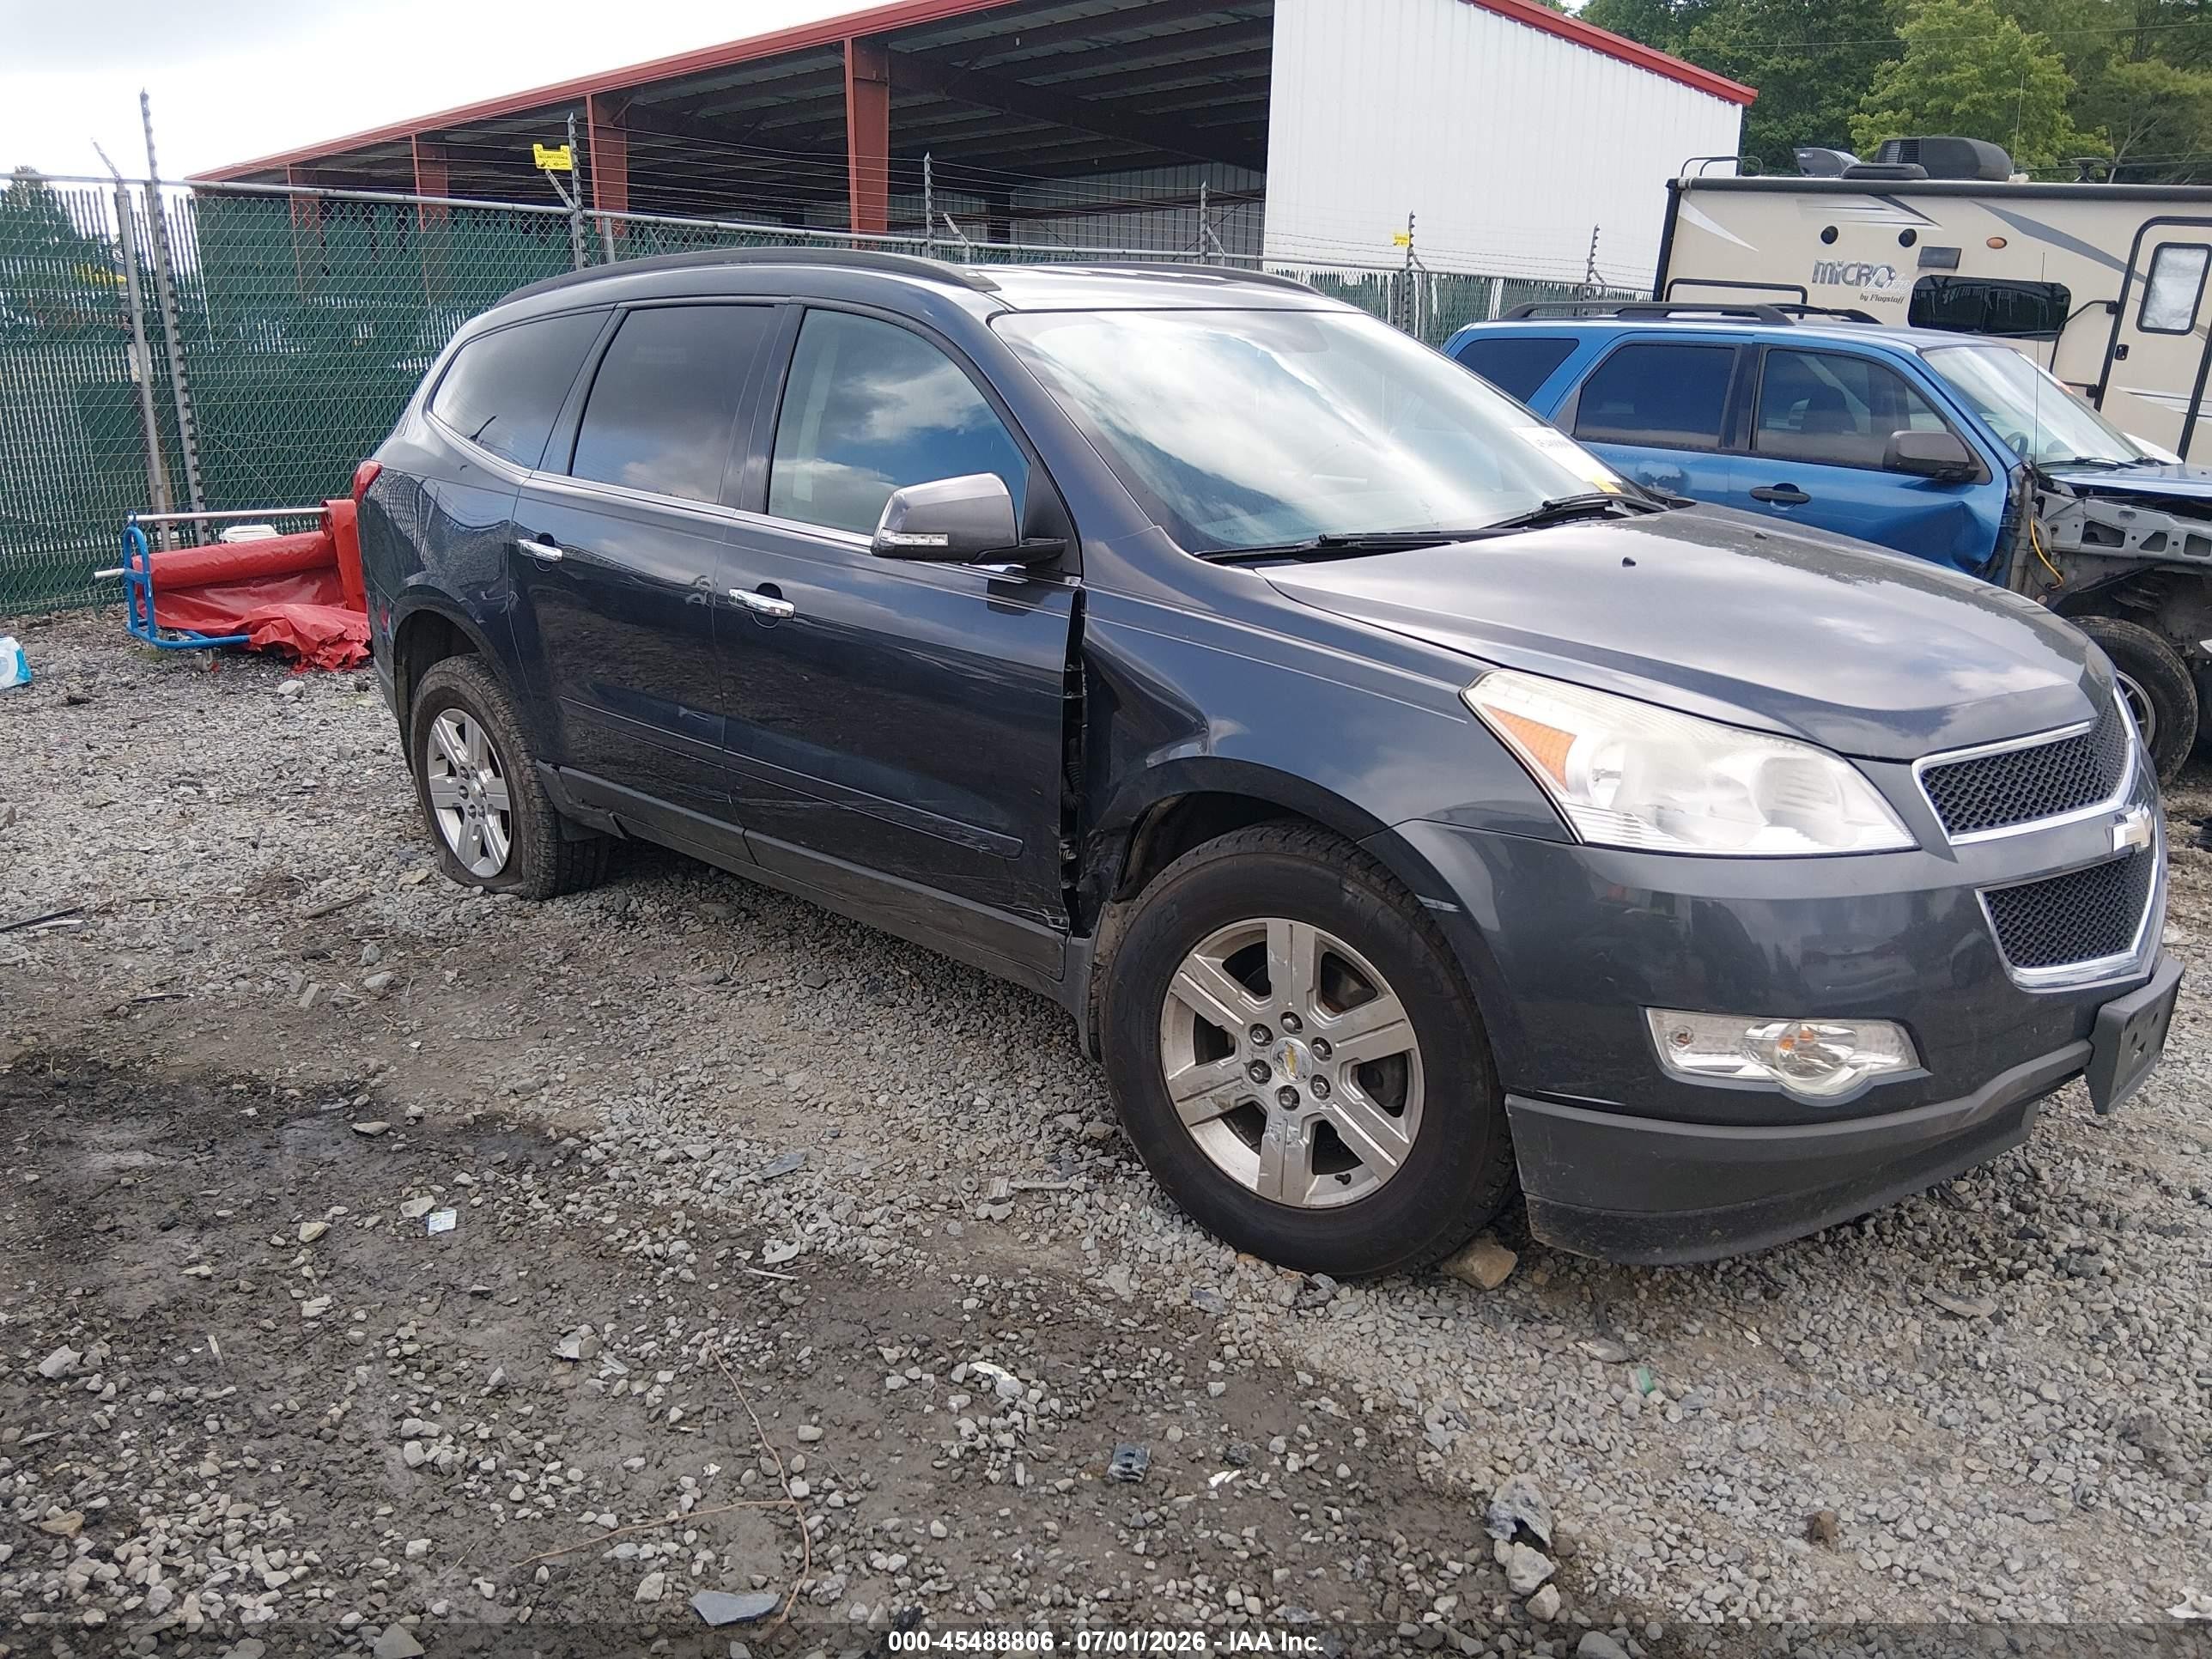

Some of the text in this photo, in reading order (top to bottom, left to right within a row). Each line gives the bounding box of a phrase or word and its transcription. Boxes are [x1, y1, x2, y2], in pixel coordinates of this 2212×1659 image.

[1862, 268, 1911, 294] Lite
[1859, 293, 1905, 304] by Flagstaff
